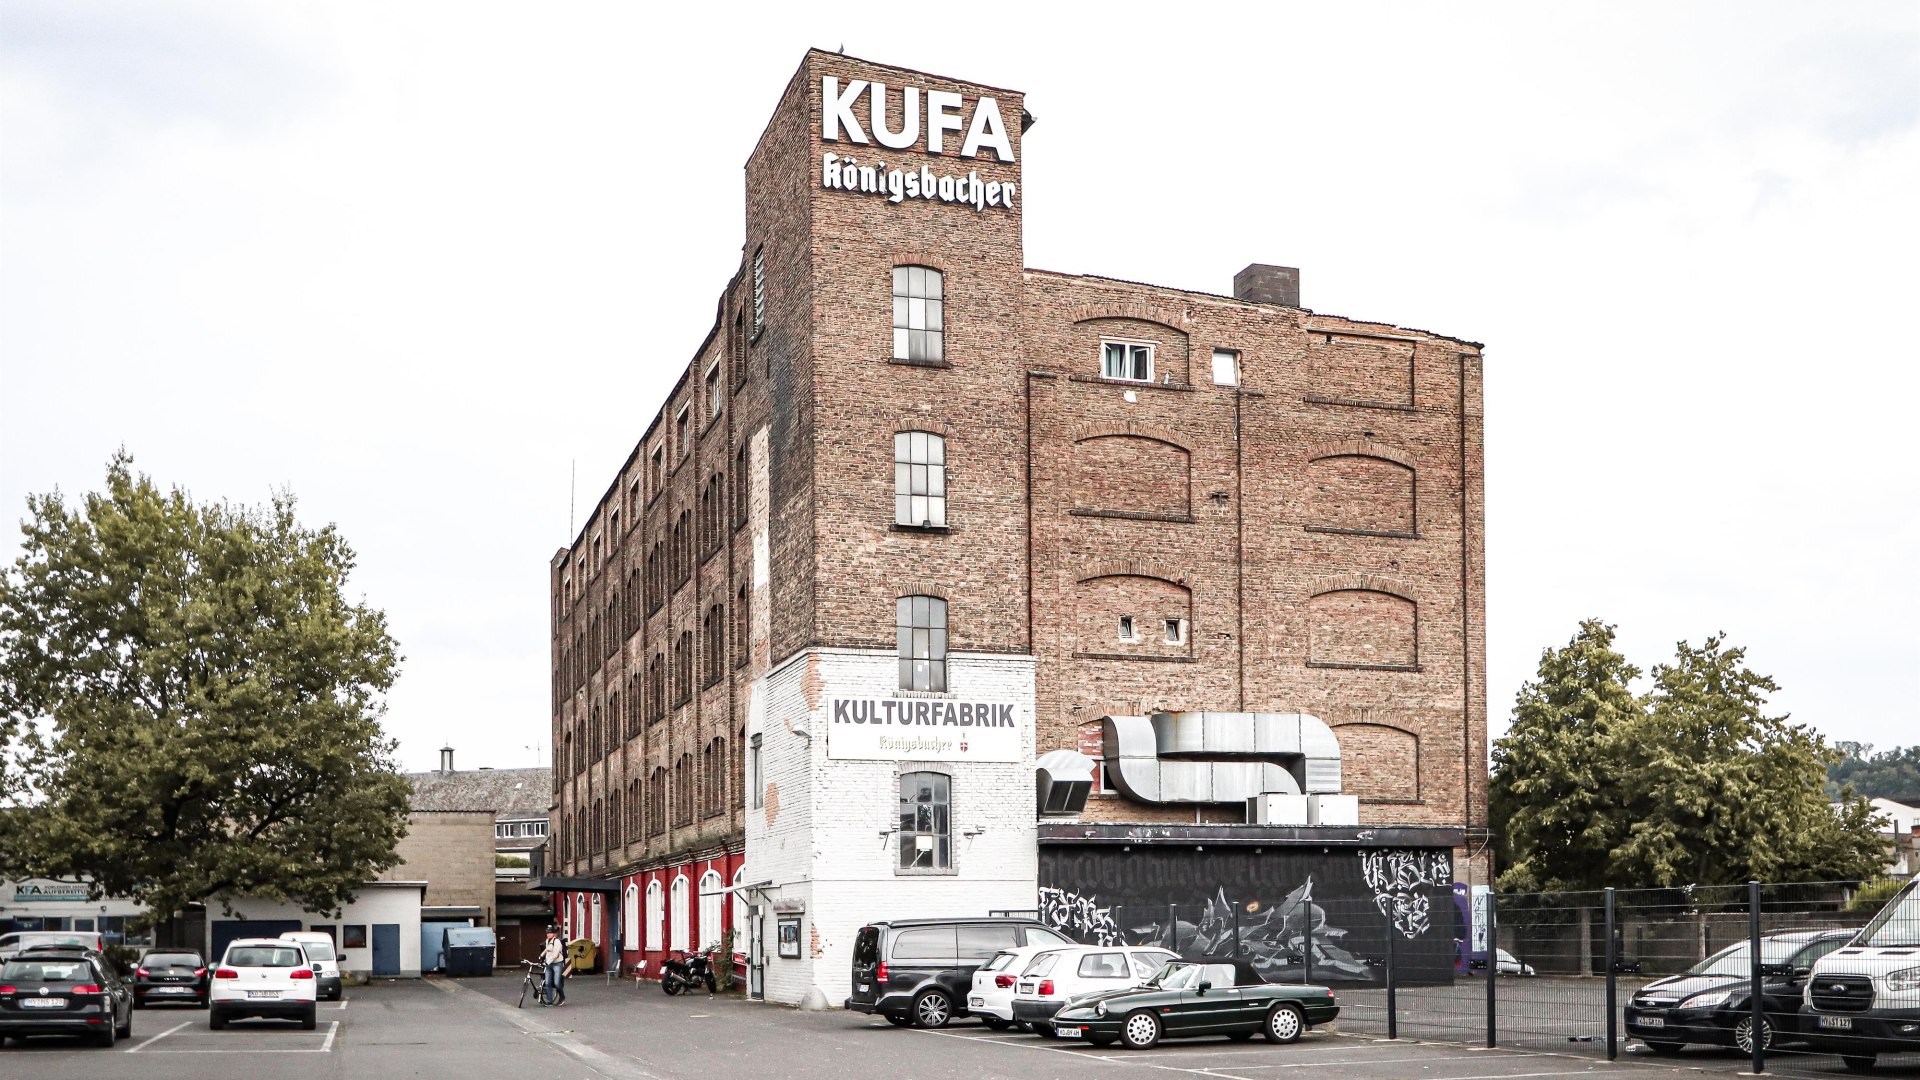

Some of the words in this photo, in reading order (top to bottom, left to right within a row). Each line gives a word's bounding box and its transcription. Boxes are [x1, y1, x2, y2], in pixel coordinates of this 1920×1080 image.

[822, 76, 1016, 164] KUFA
[822, 152, 1017, 212] Königsbacher
[834, 699, 1015, 728] KULTURFABRIK
[16, 885, 42, 895] KFA
